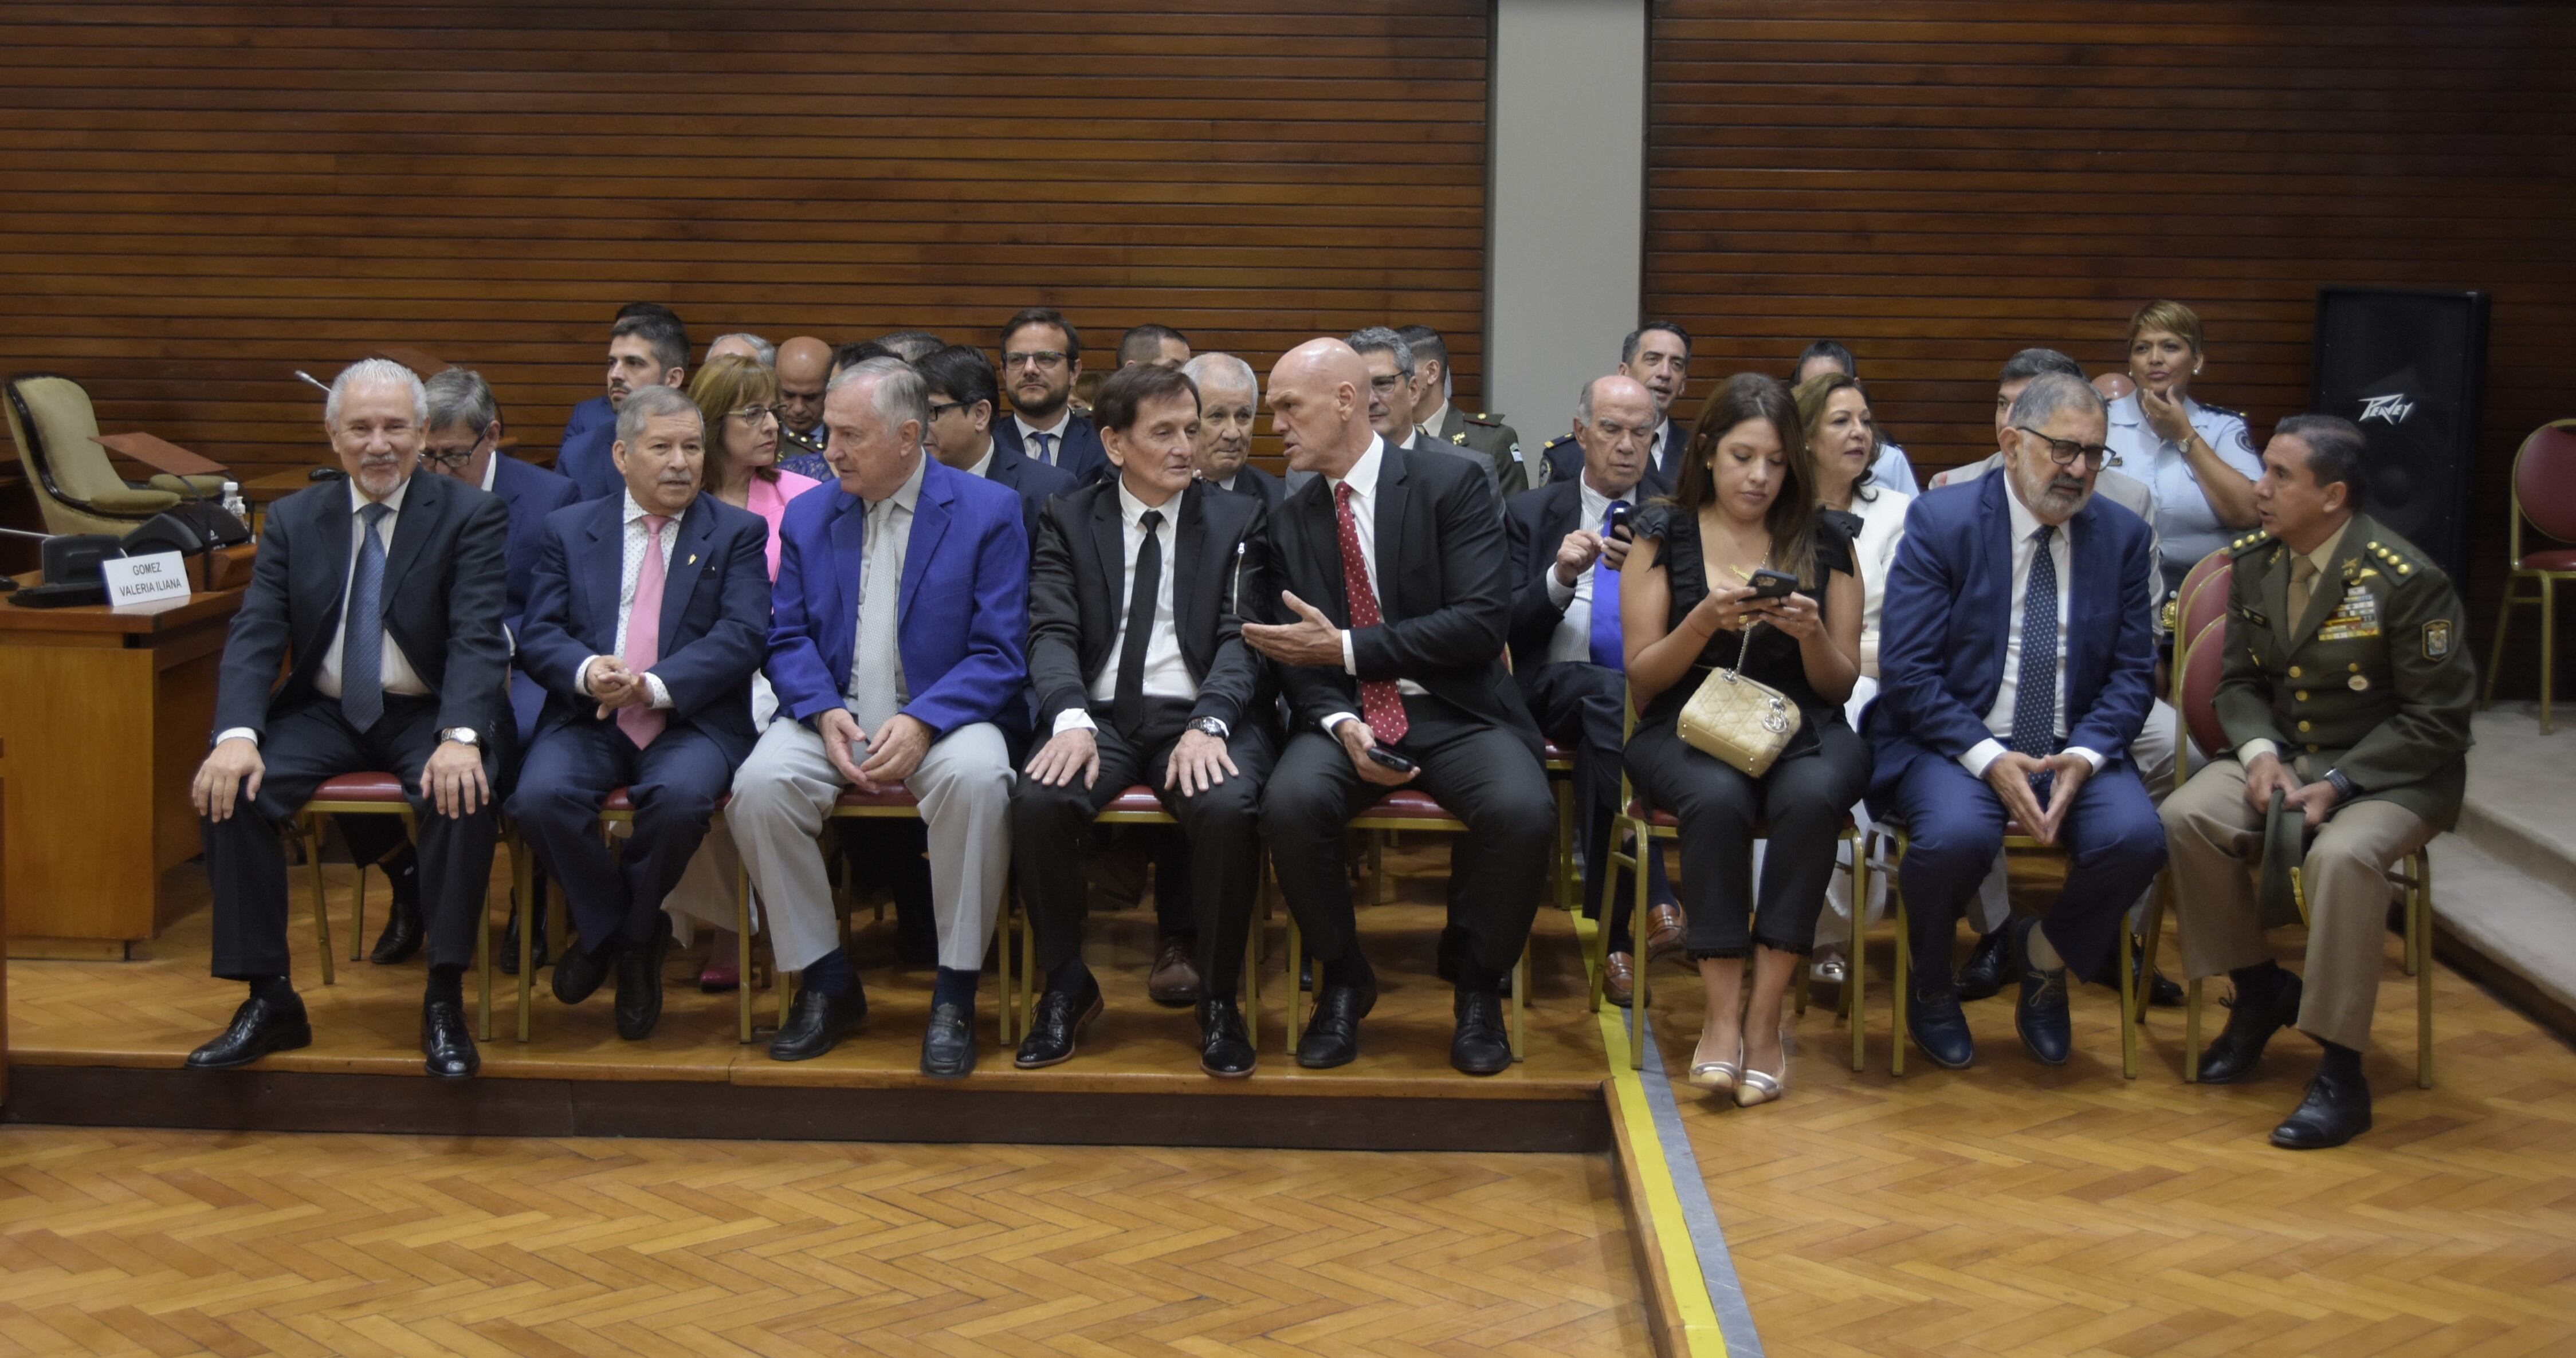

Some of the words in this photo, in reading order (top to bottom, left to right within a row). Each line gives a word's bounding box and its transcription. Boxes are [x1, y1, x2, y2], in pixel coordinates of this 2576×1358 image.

[2358, 393, 2413, 424] PEAVEY
[132, 562, 162, 576] GOMEZ
[119, 582, 155, 597] VALERIA
[156, 578, 182, 592] ILIANA
